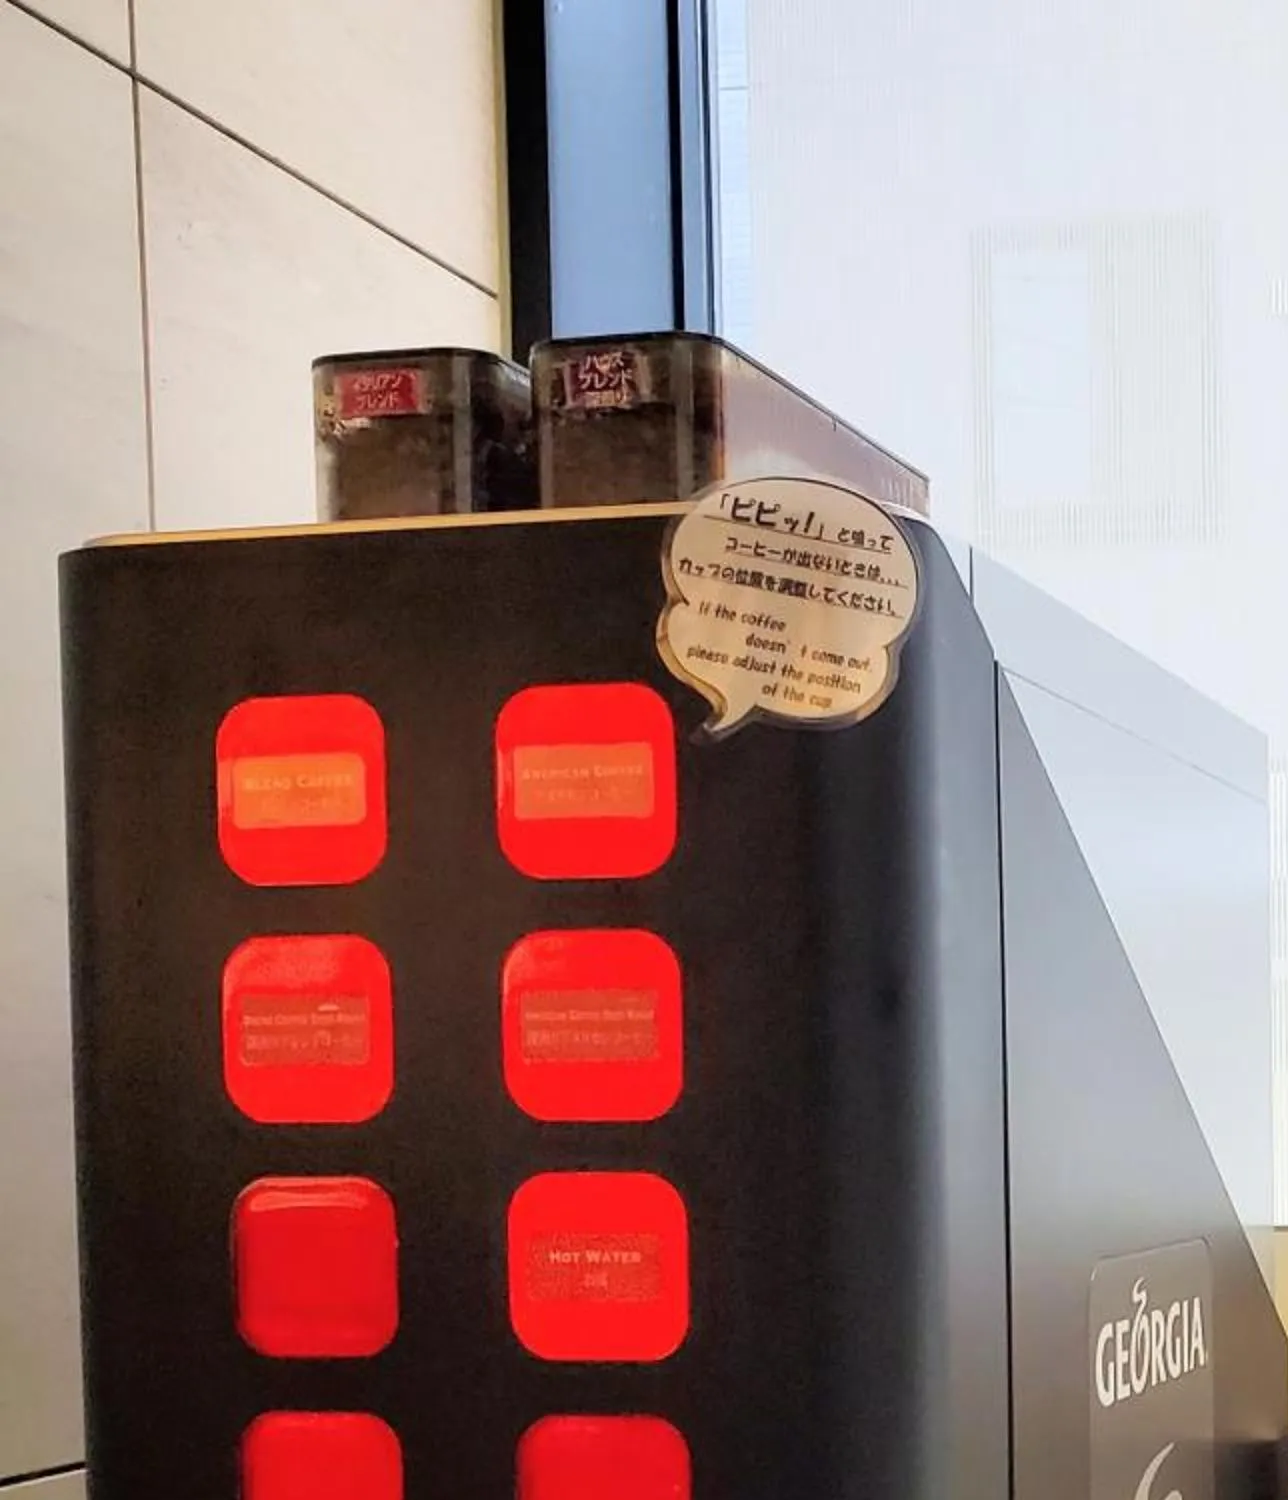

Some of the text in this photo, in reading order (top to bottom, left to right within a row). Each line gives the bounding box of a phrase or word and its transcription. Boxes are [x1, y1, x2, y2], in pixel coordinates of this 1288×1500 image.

[714, 603, 737, 621] the
[741, 611, 787, 632] coffee
[686, 644, 861, 693] please adjust the position
[811, 651, 844, 668] come
[761, 682, 777, 697] of
[783, 684, 805, 703] the
[1095, 1276, 1205, 1408] GEORGIA
